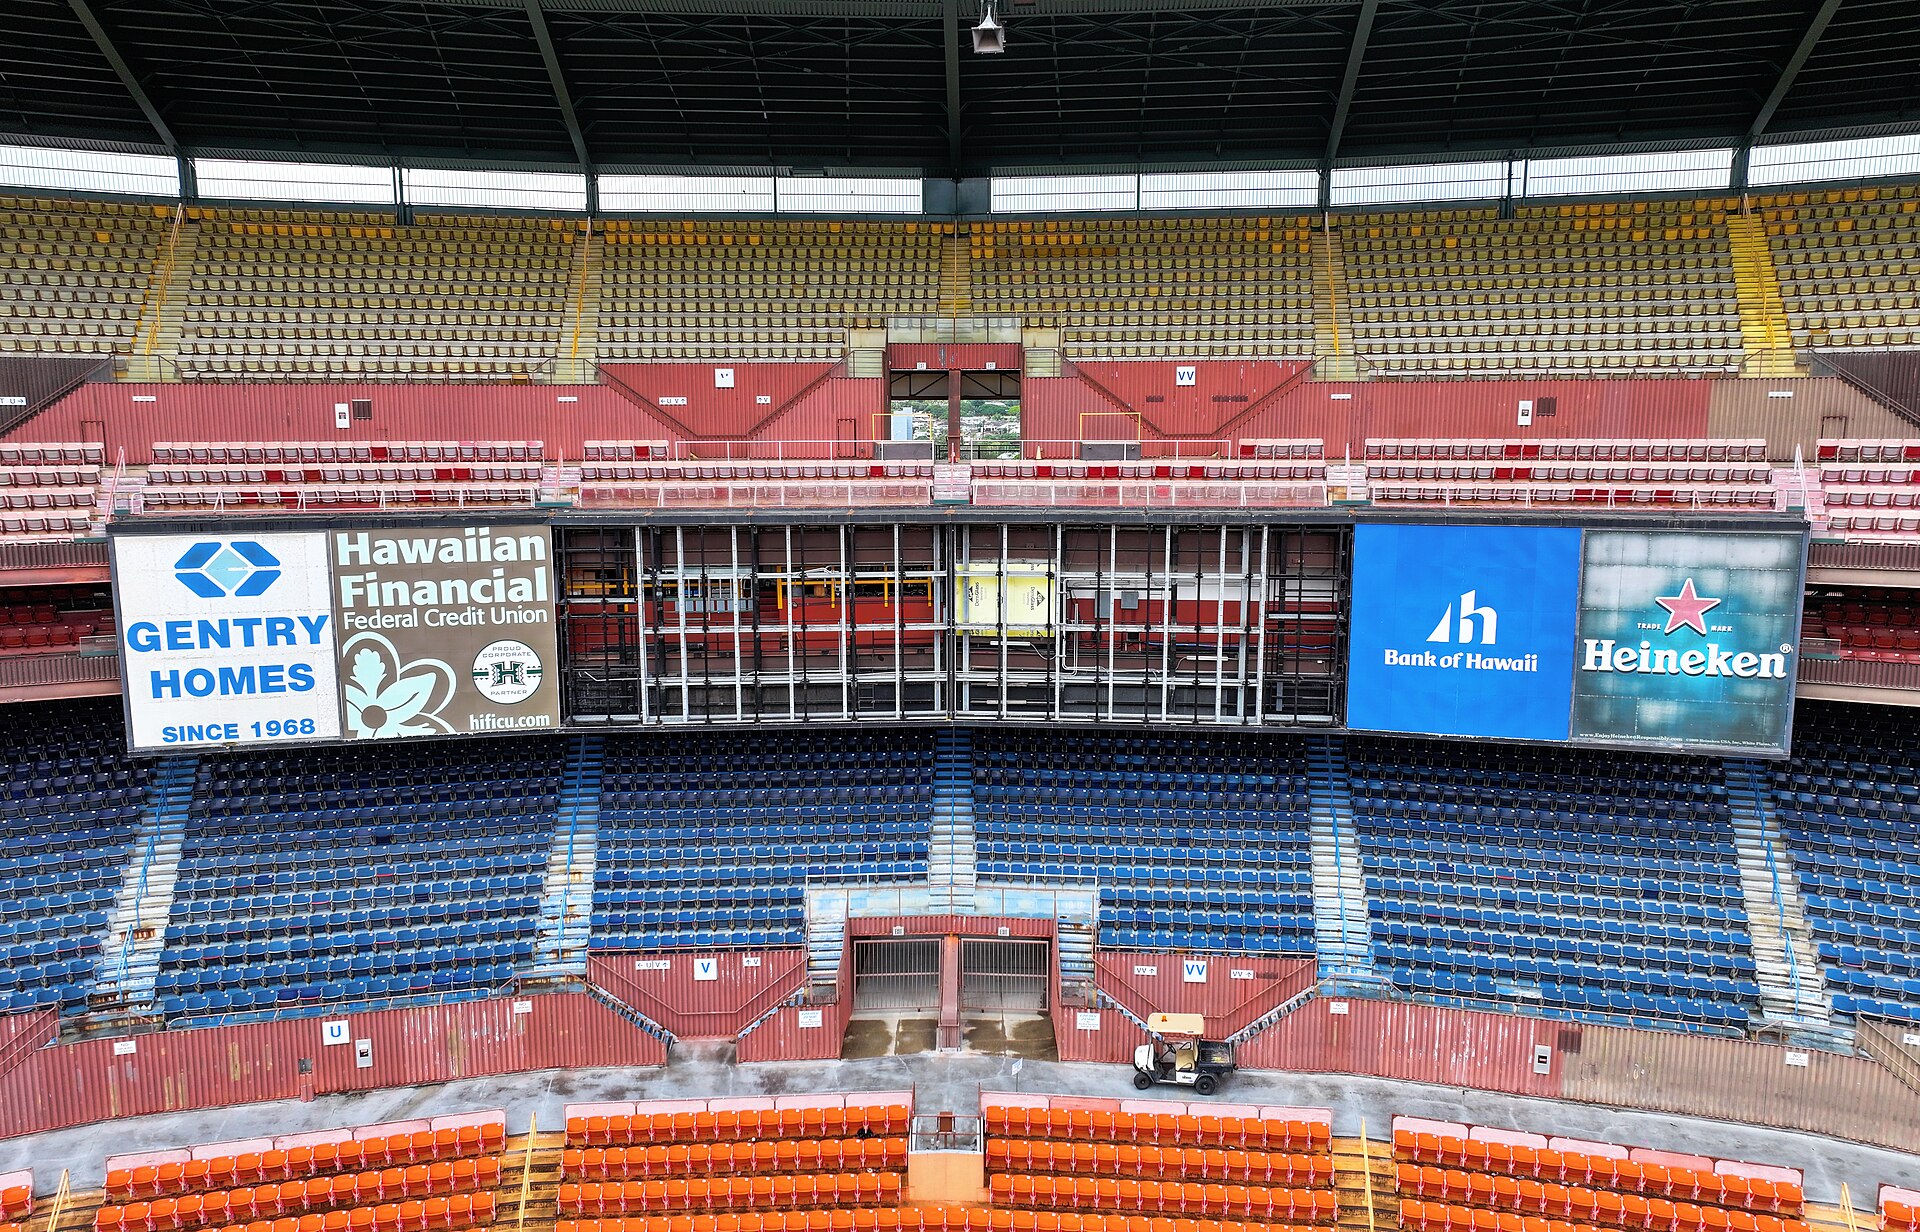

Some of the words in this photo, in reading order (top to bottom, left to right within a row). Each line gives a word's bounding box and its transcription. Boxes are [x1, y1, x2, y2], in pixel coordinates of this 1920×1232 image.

[1178, 371, 1194, 380] VV
[336, 527, 546, 566] Hawaiian
[339, 566, 548, 609] Financial
[343, 608, 419, 630] Federal
[424, 606, 486, 627] Credit
[491, 605, 548, 625] Union
[1637, 622, 1661, 630] TRADE
[127, 614, 329, 652] GENTRY
[1384, 649, 1437, 667] Bank
[1439, 652, 1464, 669] of
[1468, 652, 1538, 672] Hawaii
[150, 663, 316, 699] HOMES
[162, 723, 240, 743] SINCE
[250, 718, 316, 738] 1968
[469, 713, 550, 731] hificu.com
[701, 962, 711, 974] V
[1185, 964, 1206, 976] VV
[330, 1025, 341, 1038] U
